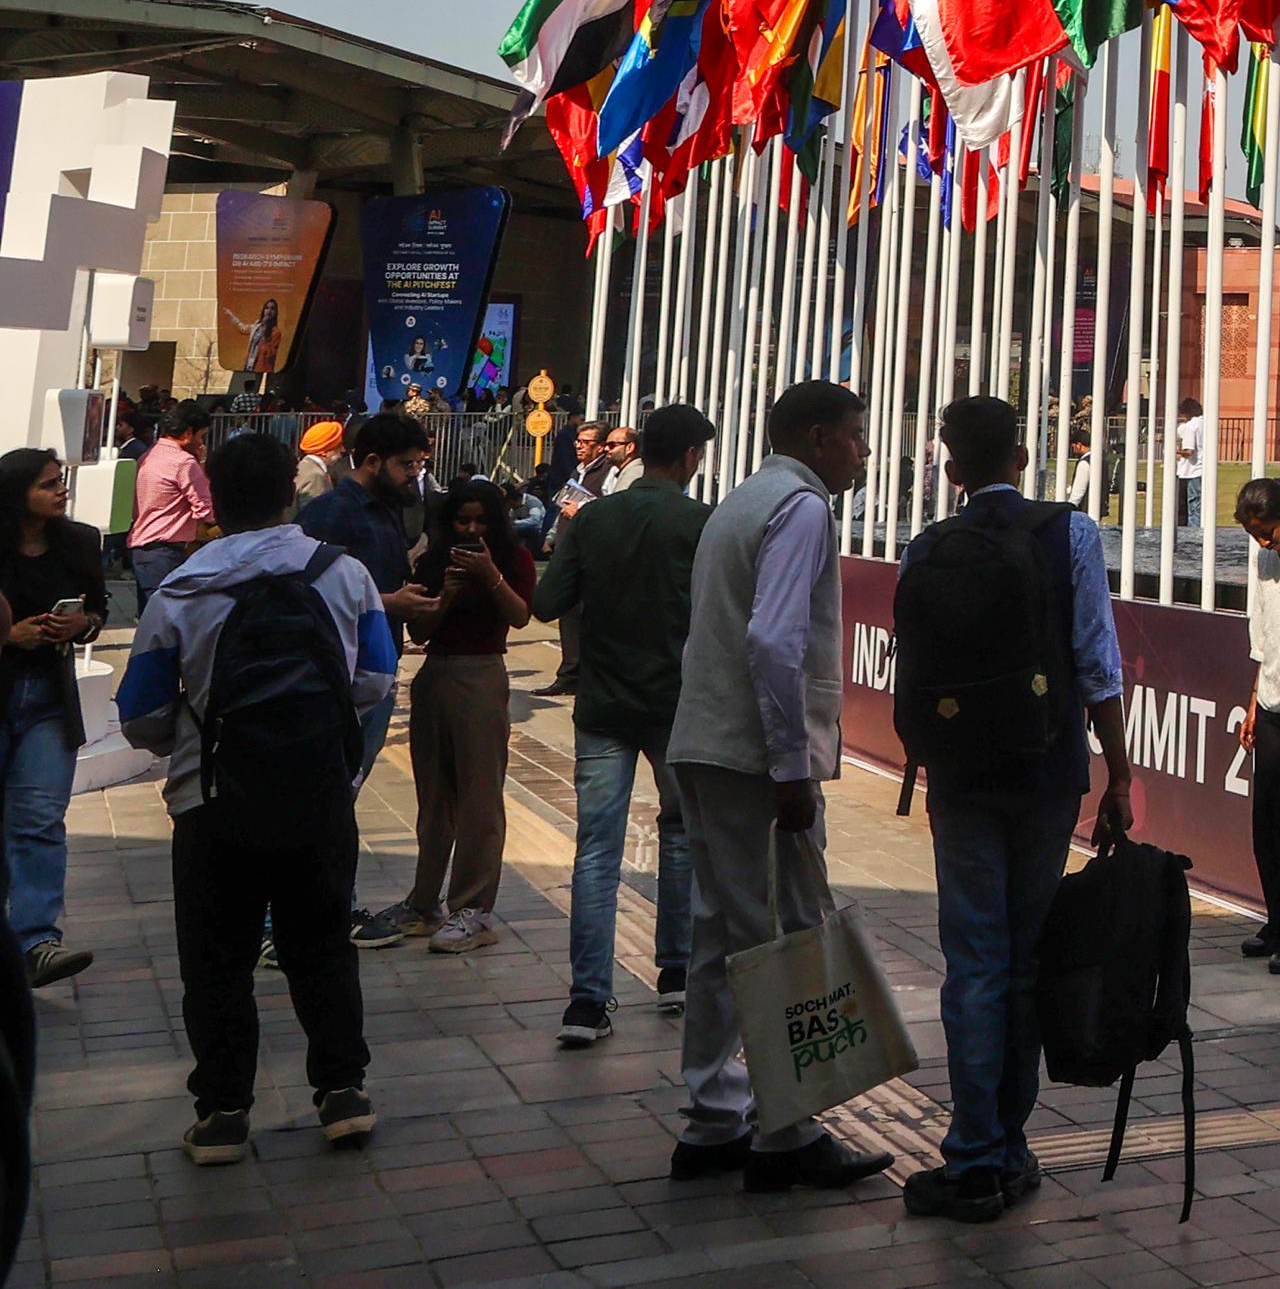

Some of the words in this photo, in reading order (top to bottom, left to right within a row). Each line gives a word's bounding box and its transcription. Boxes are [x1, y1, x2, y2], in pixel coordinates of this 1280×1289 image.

[429, 209, 441, 221] AI
[386, 263, 421, 271] EXPLORE
[423, 263, 460, 271] GROWTH
[385, 272, 447, 280] OPPORTUNITIES
[448, 272, 460, 280] AT
[386, 280, 402, 288] THE
[403, 280, 412, 288] AI
[412, 280, 457, 288] PITCHFEST
[852, 622, 897, 695] INDI
[1087, 684, 1217, 784] MMIT
[785, 997, 828, 1020] SOCH
[828, 982, 856, 1005] MAT.
[787, 1008, 830, 1047] BAS
